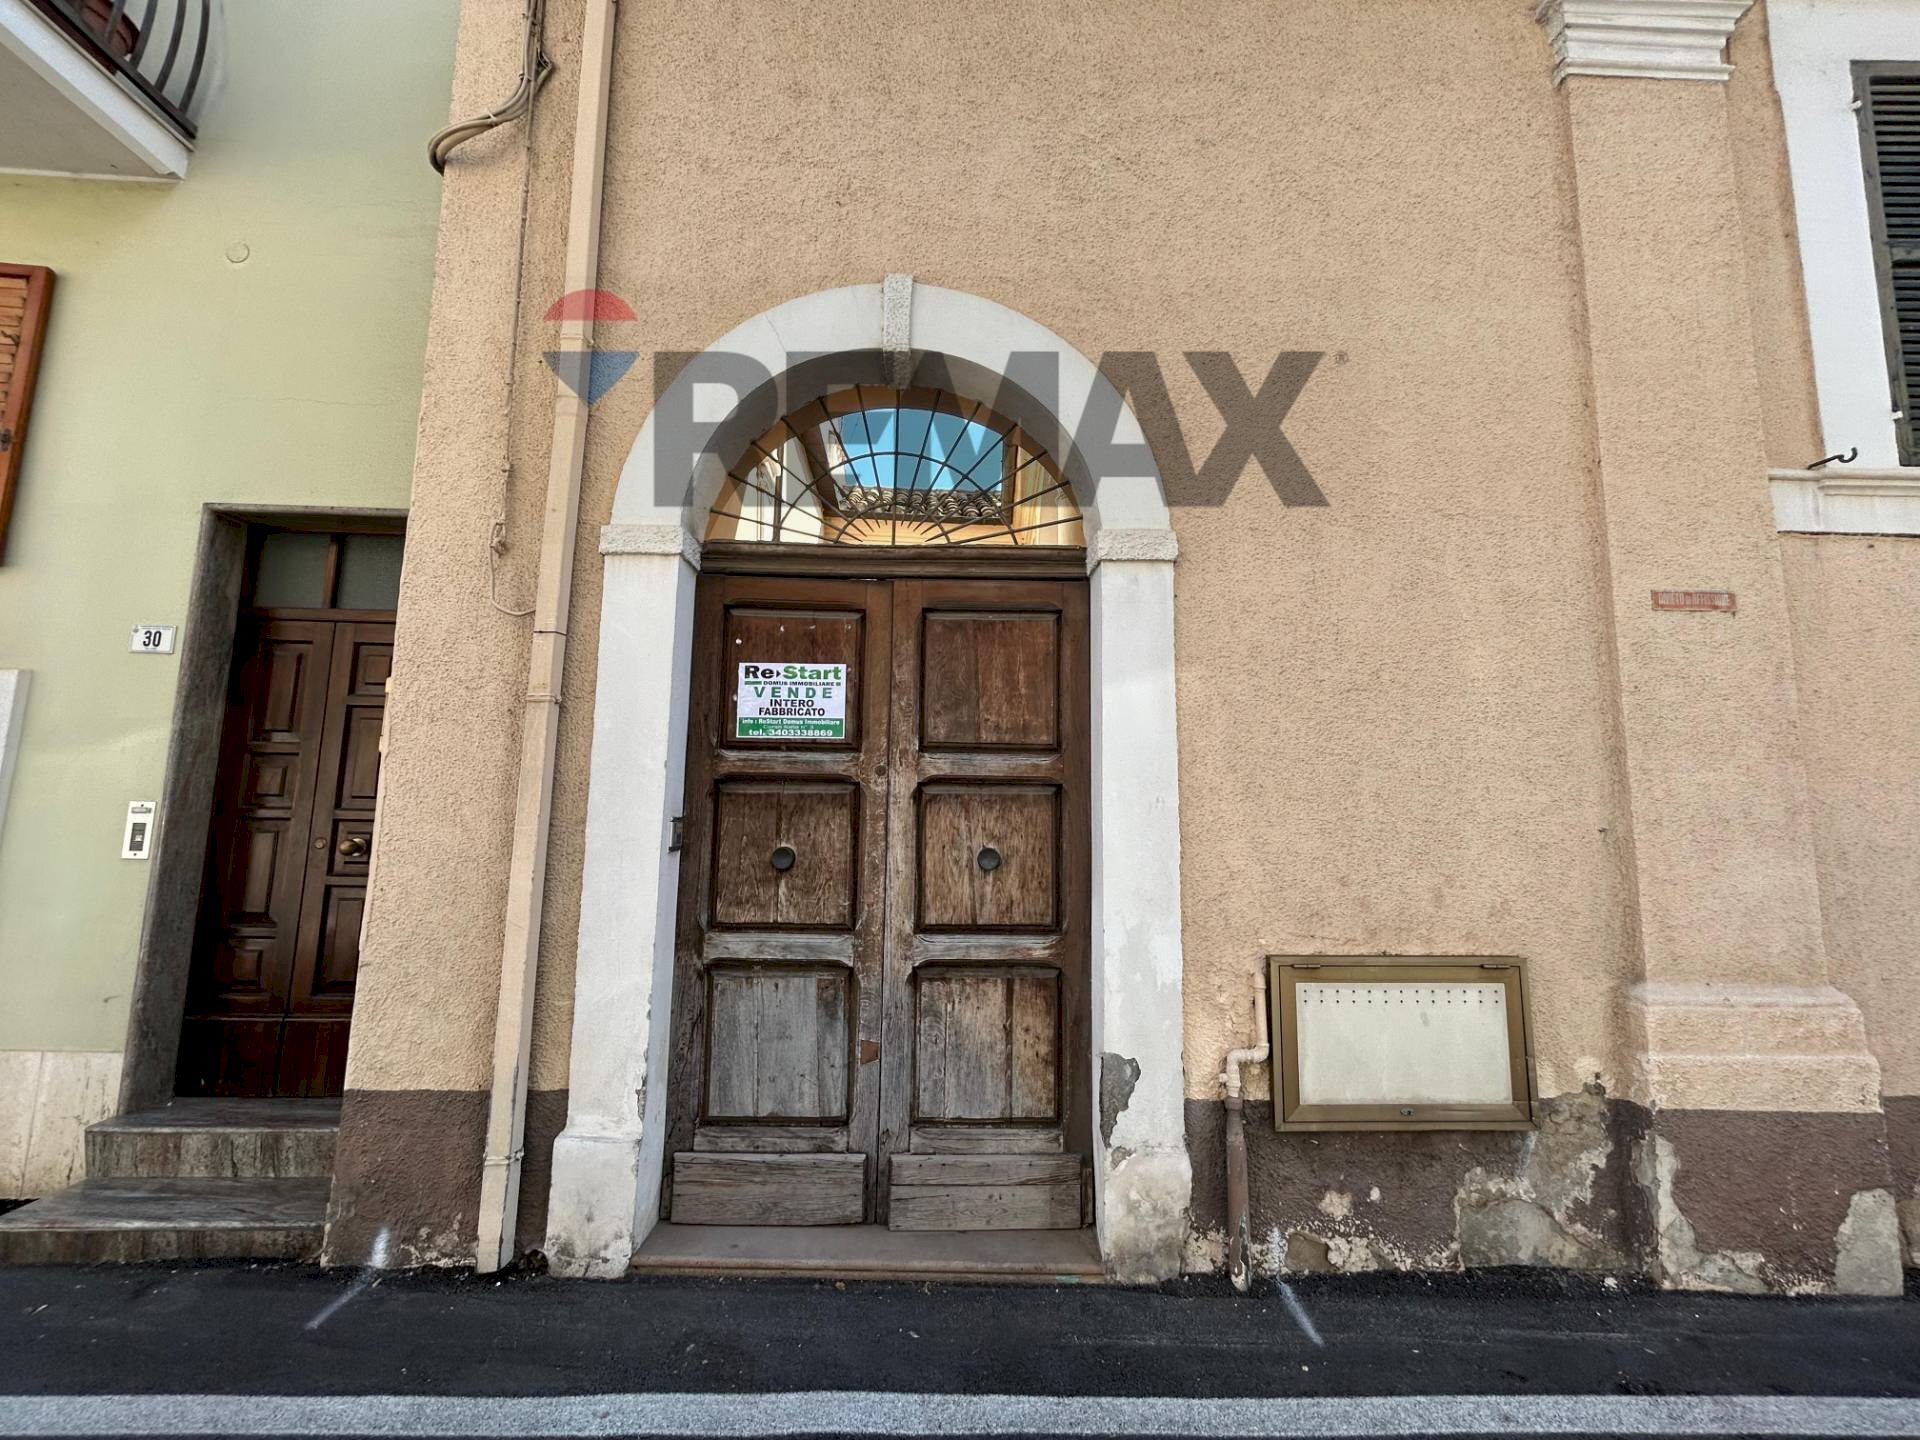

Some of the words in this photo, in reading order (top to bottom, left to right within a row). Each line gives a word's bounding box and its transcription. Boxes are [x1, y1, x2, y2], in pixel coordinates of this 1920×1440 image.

[142, 630, 162, 647] 30
[754, 686, 832, 698] VENDE
[770, 699, 814, 708] INTERO
[758, 708, 826, 716] FABBRICATO
